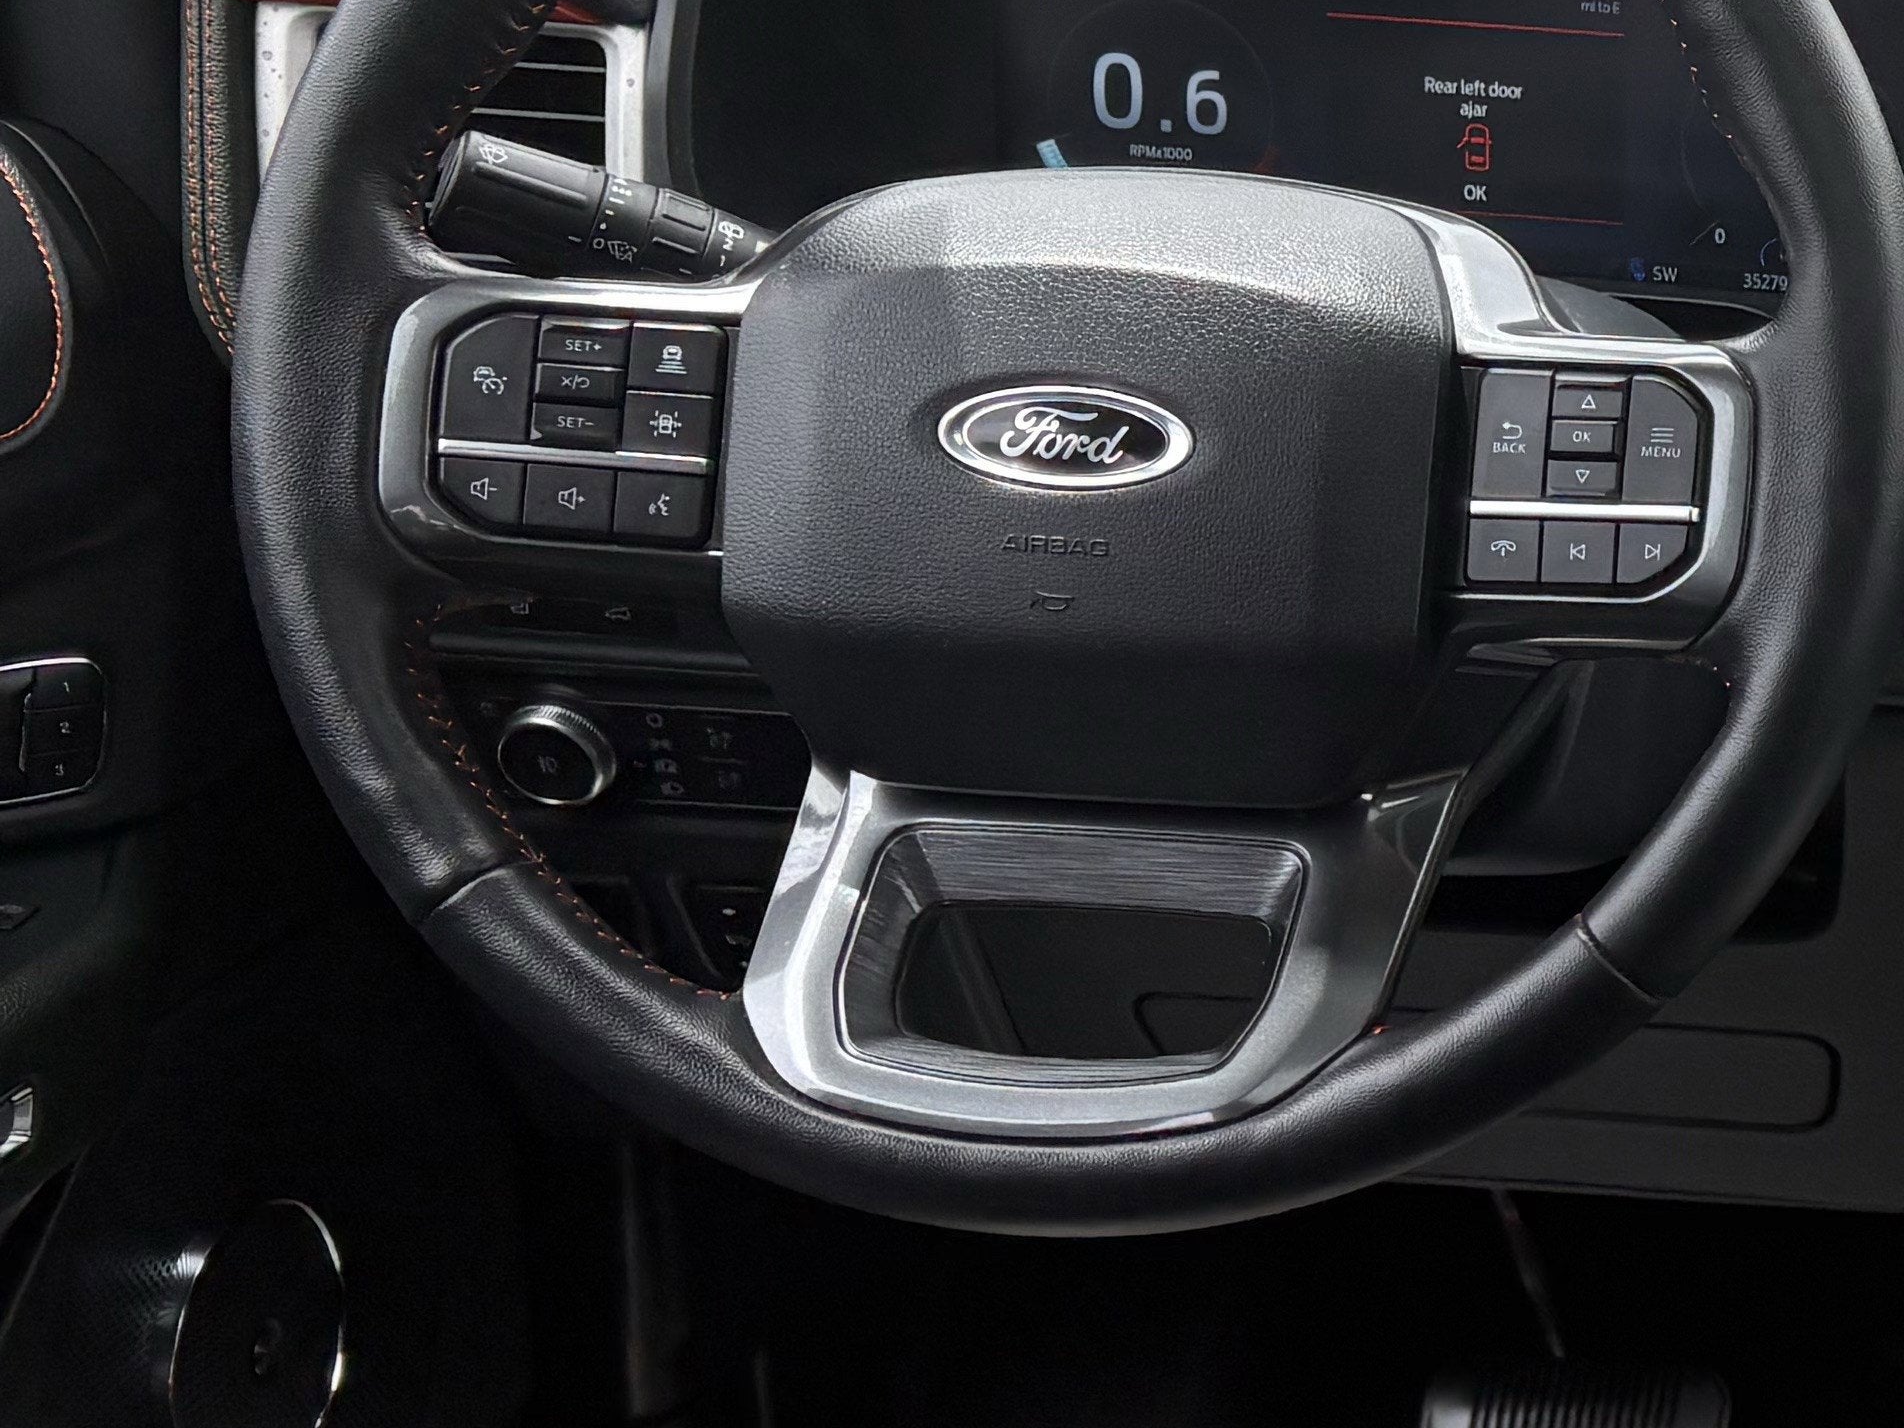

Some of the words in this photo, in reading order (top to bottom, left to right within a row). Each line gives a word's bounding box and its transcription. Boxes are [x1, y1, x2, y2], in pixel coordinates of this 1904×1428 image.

[1092, 51, 1229, 136] 0.6
[1424, 75, 1459, 96] Rear
[1460, 78, 1486, 98] left
[1488, 80, 1523, 100] door
[1459, 100, 1488, 120] ajar
[1463, 184, 1488, 202] OK
[1652, 265, 1678, 284] SW
[1742, 272, 1788, 292] 35279
[565, 338, 602, 352] SET+
[1000, 405, 1130, 465] Ford
[1572, 429, 1592, 444] OK
[1492, 440, 1527, 455] BACK
[1640, 444, 1681, 459] MENU
[1000, 533, 1111, 557] AIRBAG
